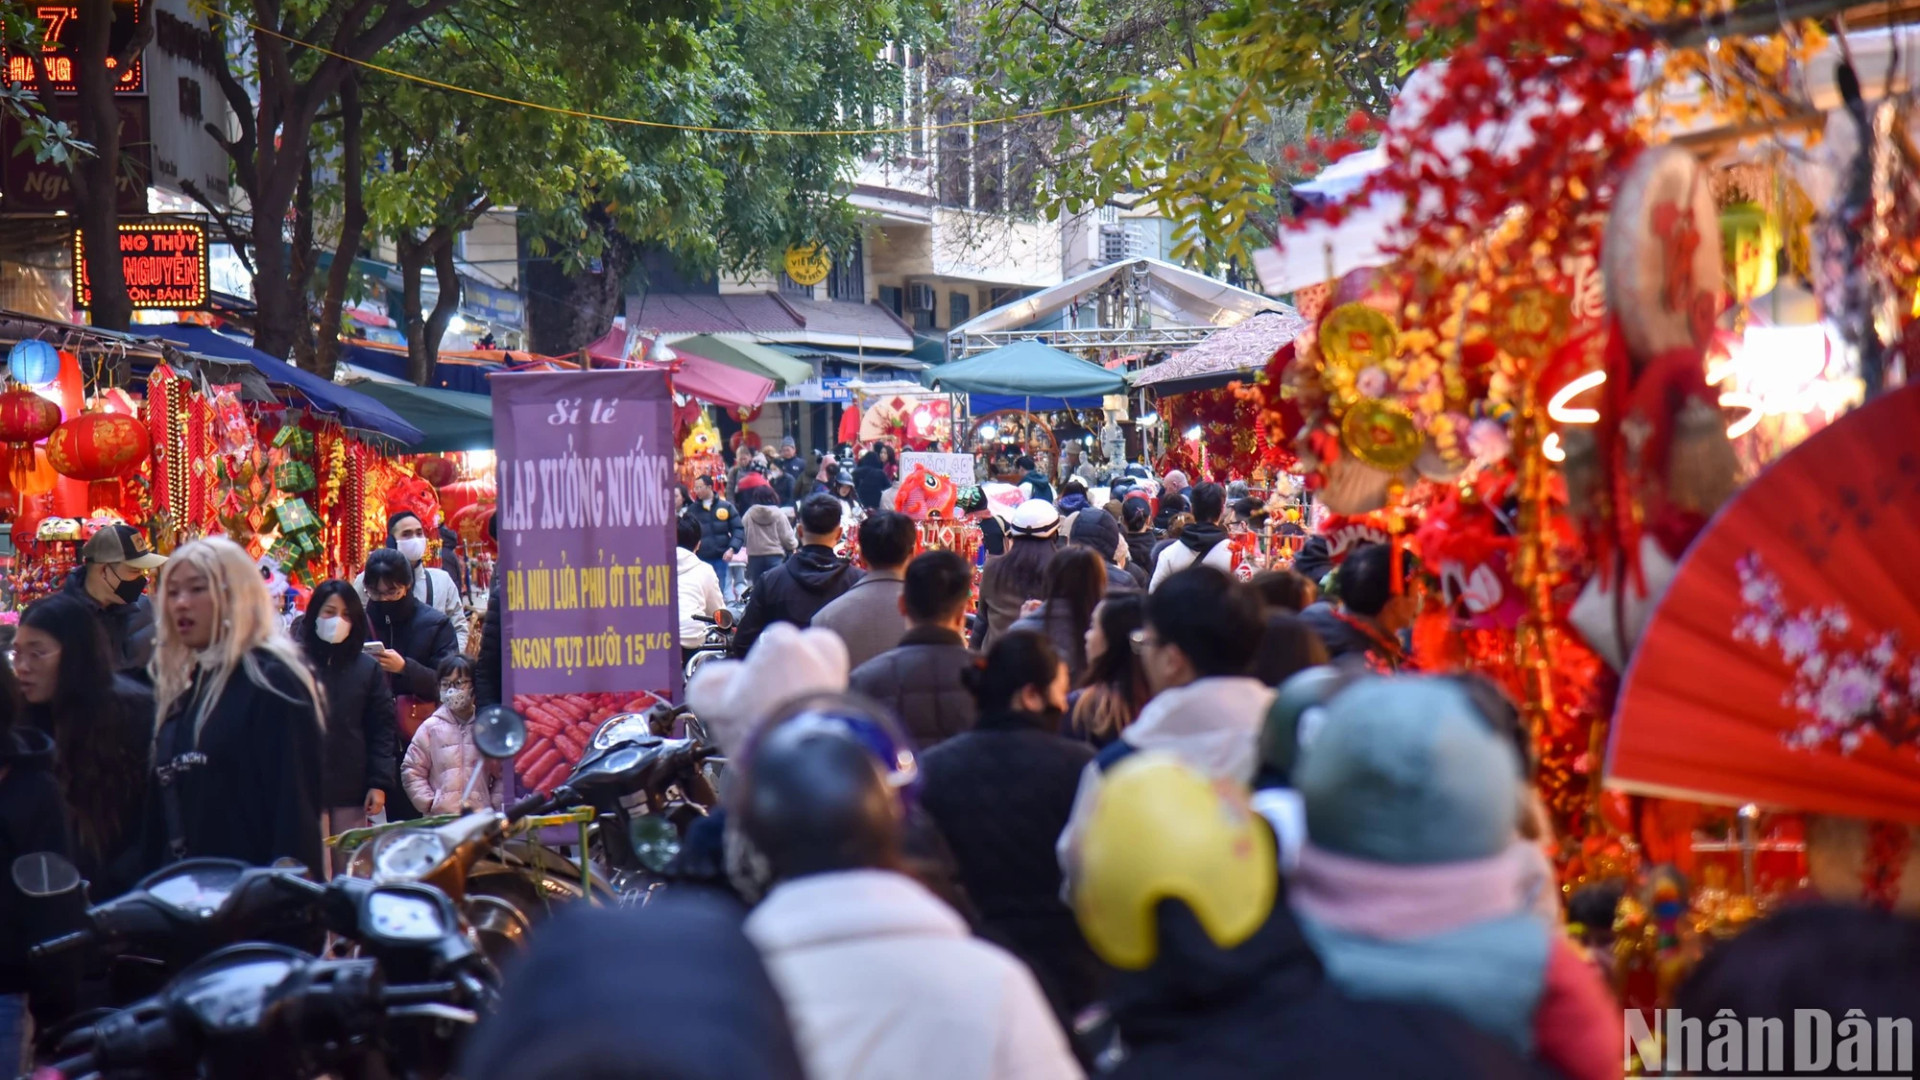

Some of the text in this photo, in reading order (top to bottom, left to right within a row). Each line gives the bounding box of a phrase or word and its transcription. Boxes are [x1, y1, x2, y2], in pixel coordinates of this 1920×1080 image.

[120, 234, 149, 251] NG
[500, 433, 671, 547] LẠP XƯỞNG NƯỚNG
[507, 549, 670, 611] ĐÁ NÚI LỬA PHỦ ỚT TÊ CAY
[510, 637, 552, 669] NGON
[554, 636, 584, 676] TỤT
[586, 626, 622, 668] LƯỠI
